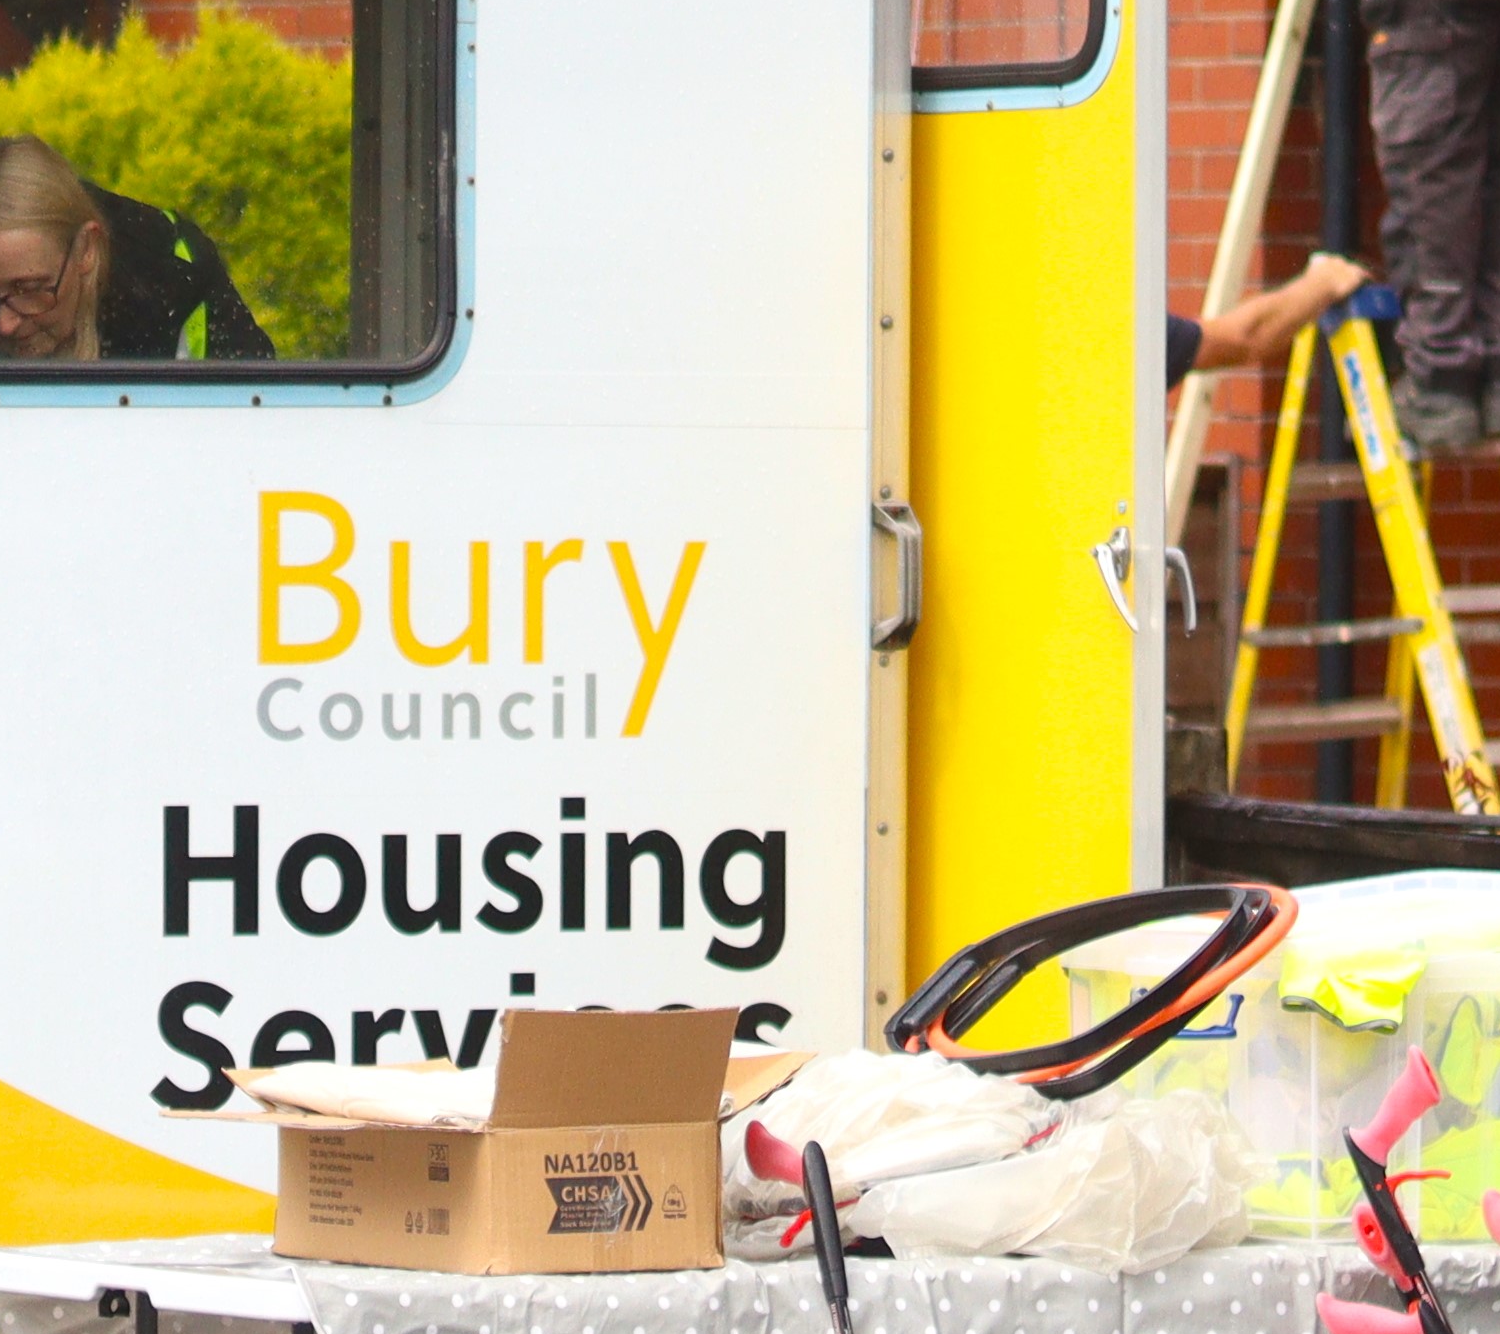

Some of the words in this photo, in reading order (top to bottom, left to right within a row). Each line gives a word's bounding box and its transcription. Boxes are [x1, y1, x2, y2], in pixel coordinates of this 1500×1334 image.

[257, 489, 708, 738] Bury
[256, 673, 597, 742] Council
[164, 797, 786, 971] Housing
[150, 971, 795, 1112] Serv
[544, 1151, 639, 1174] NA120B1
[561, 1185, 612, 1203] CHSA
